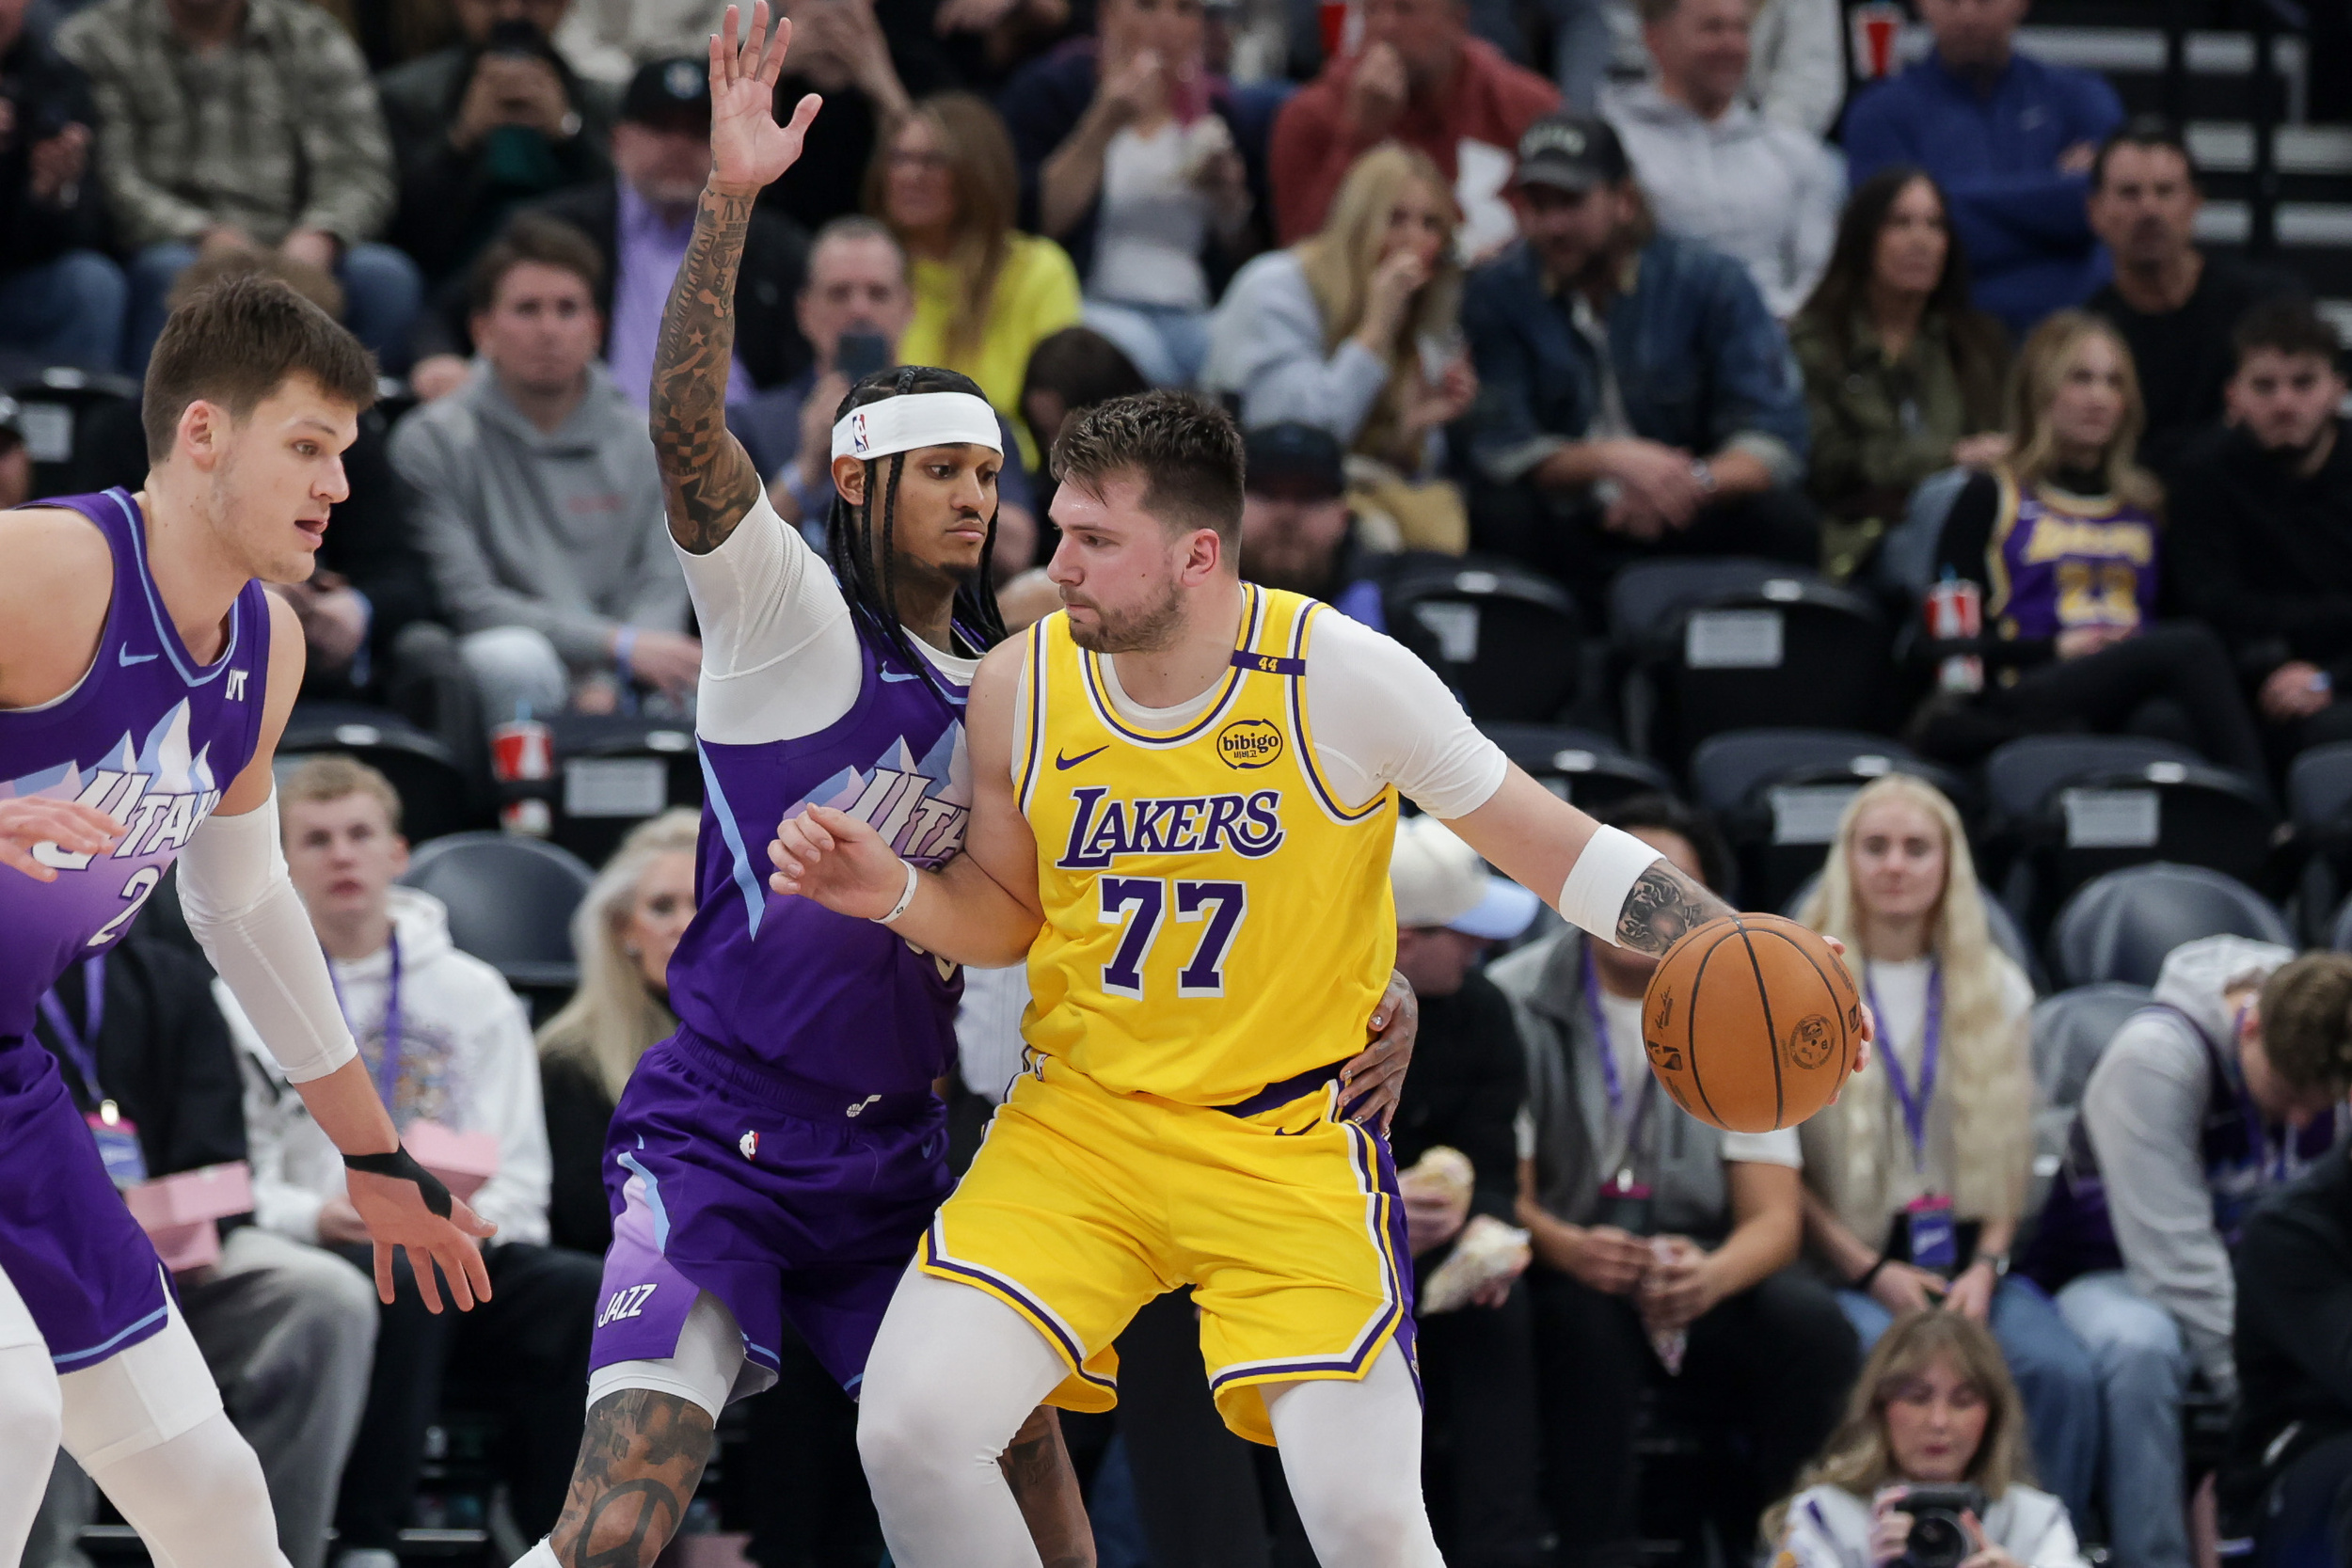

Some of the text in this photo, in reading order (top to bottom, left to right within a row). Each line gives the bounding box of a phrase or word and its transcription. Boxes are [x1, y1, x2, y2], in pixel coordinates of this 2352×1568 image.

[1258, 657, 1279, 672] 44
[1223, 733, 1279, 753] bibigo
[1054, 784, 1287, 870] LAKERS
[1098, 874, 1248, 1003] 77
[597, 1283, 658, 1328] JAZZ
